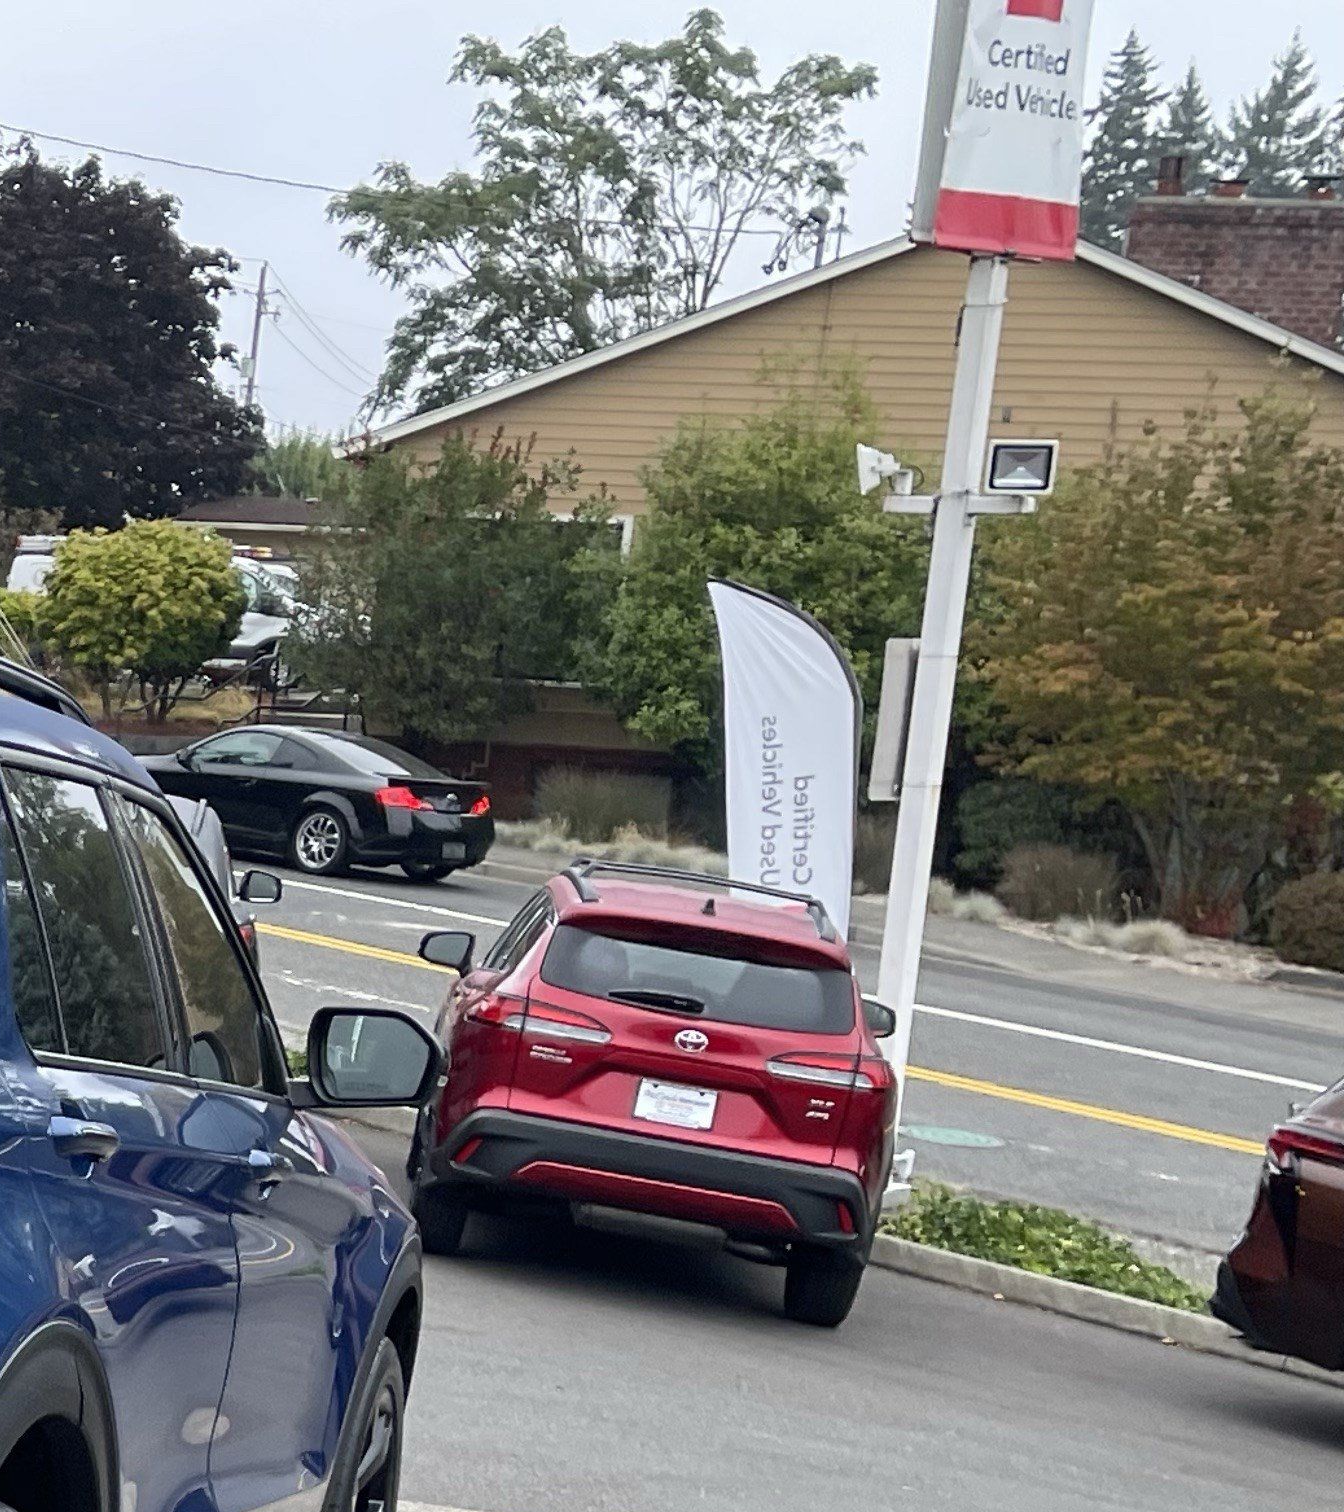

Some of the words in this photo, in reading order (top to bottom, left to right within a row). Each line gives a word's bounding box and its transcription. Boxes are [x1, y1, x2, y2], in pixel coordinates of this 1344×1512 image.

[989, 39, 1071, 76] Certified
[966, 77, 1010, 110] Used
[1015, 83, 1078, 120] Vehicle
